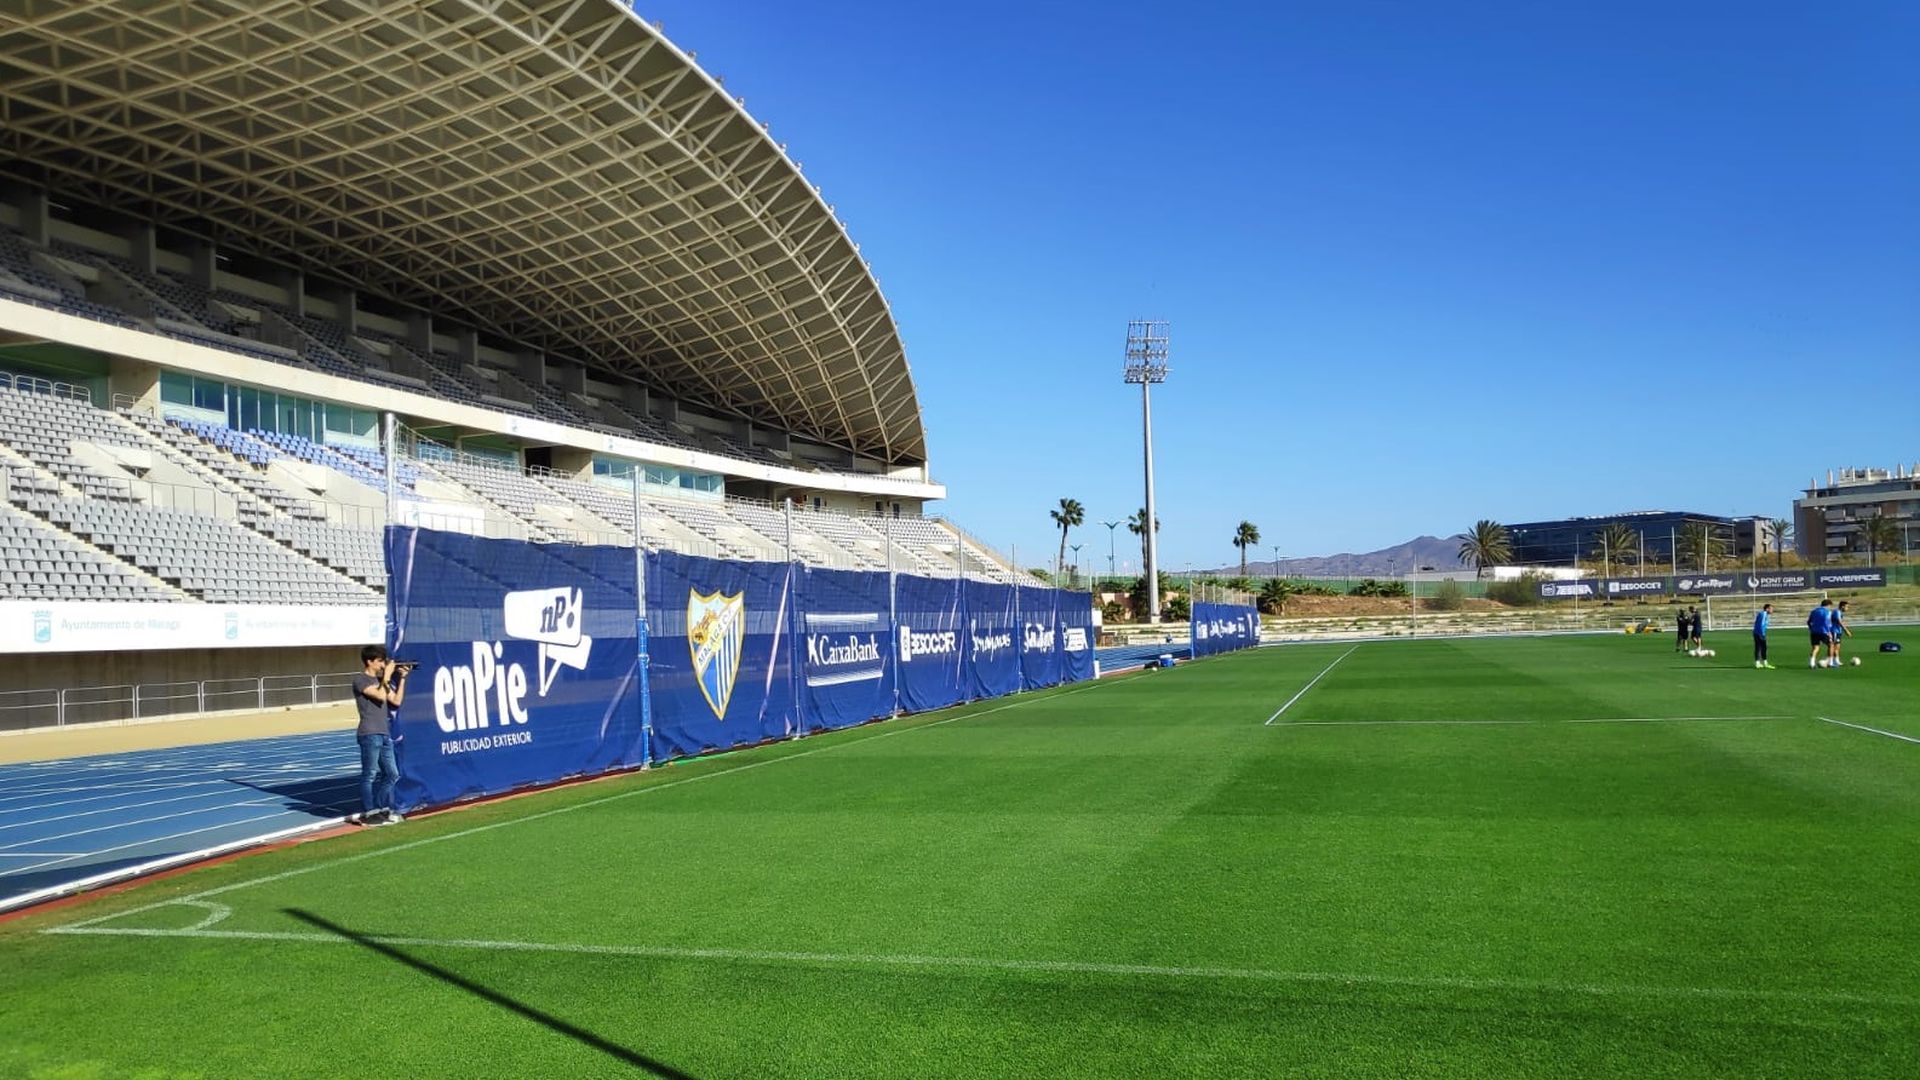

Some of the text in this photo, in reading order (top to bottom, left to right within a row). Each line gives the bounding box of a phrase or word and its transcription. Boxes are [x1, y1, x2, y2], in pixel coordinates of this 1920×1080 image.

[819, 634, 880, 665] CaixaBank
[434, 640, 528, 733] enPie
[441, 731, 532, 755] PUBLICIDAD EXTERIOR
